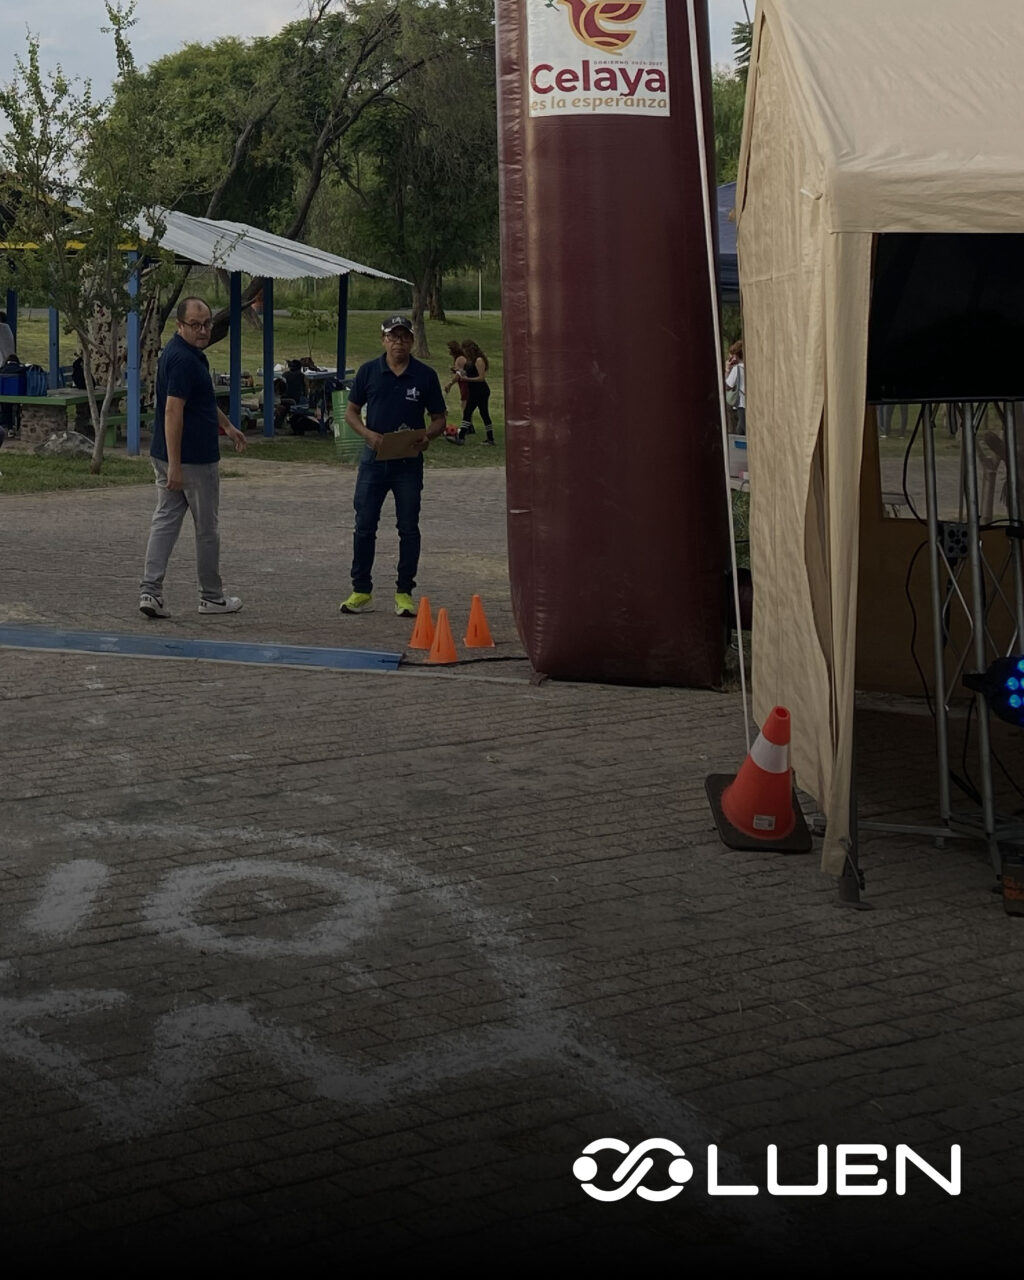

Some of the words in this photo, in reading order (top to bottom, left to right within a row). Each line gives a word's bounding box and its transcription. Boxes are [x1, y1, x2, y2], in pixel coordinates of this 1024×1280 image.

[530, 60, 667, 97] Celaya
[531, 100, 547, 111] es
[551, 96, 566, 109] la
[571, 96, 667, 111] esperanza
